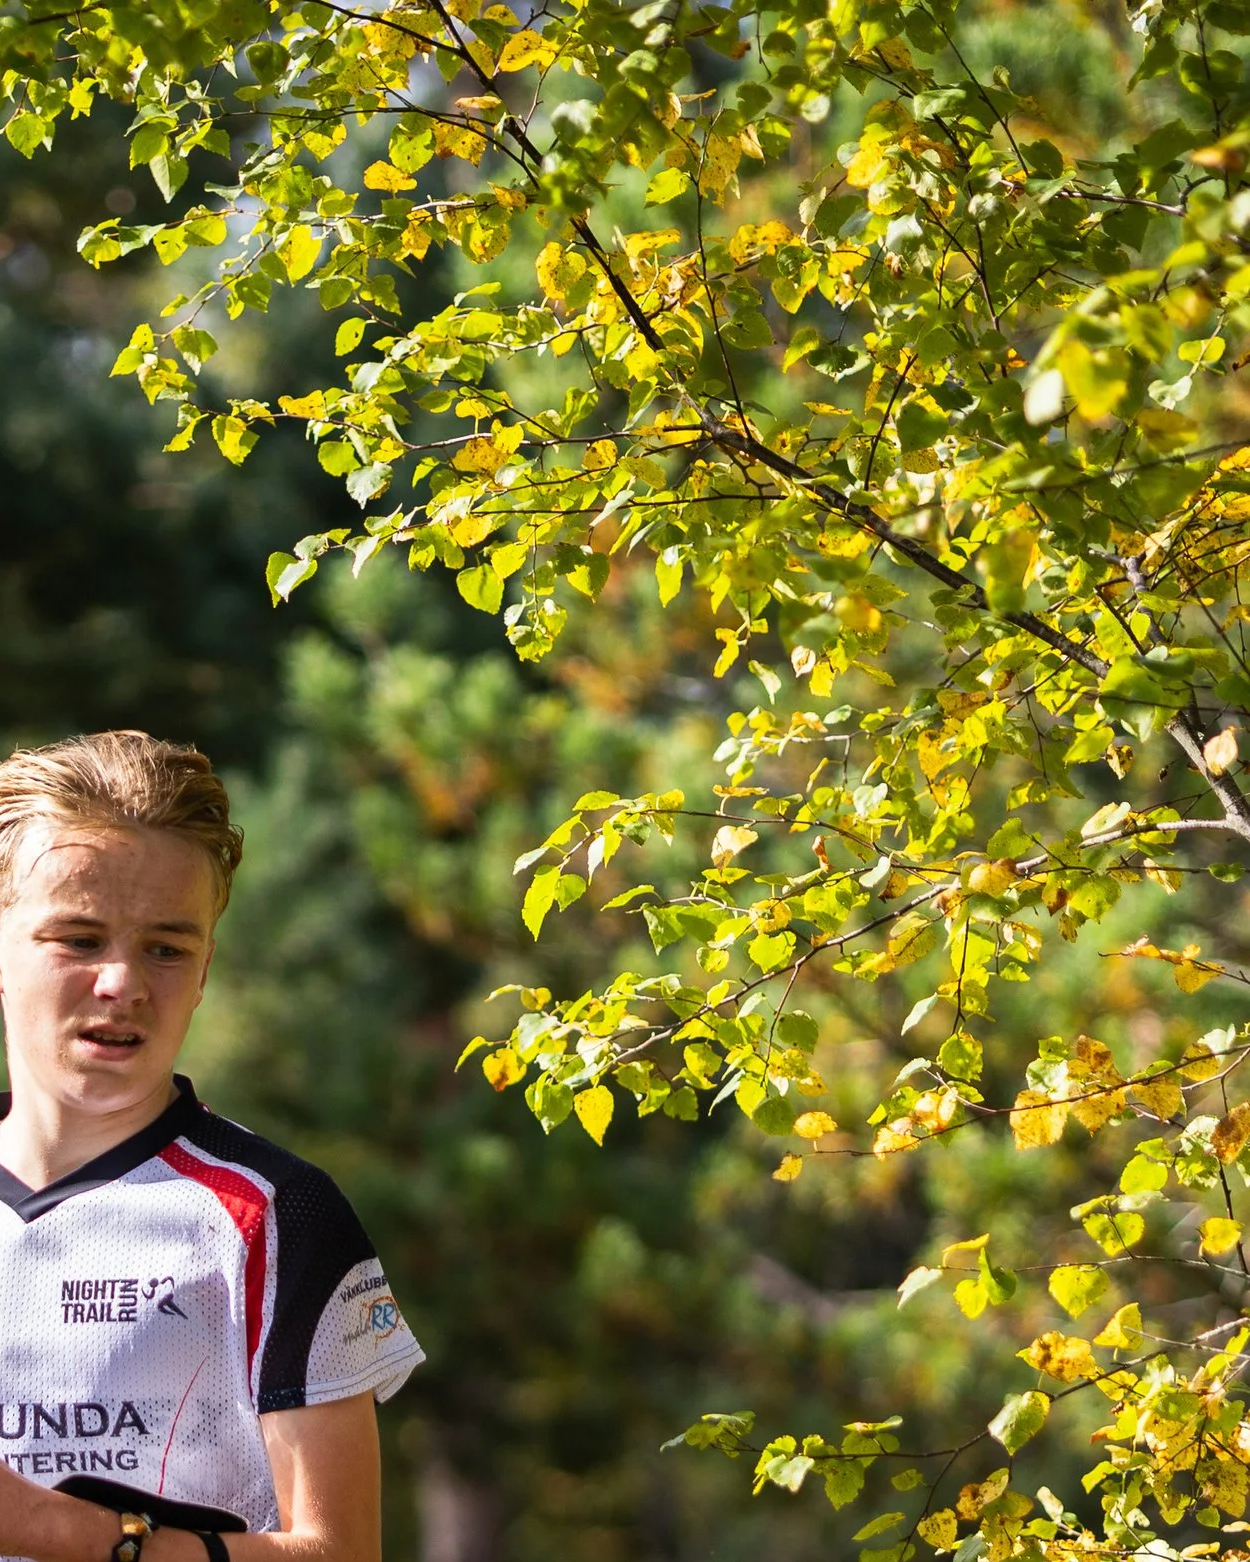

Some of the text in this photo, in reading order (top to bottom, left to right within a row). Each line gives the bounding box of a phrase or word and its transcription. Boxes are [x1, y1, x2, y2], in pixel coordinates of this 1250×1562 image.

[61, 1278, 120, 1301] NIGHT
[117, 1278, 138, 1322] RUN
[61, 1302, 117, 1323] TRAIL
